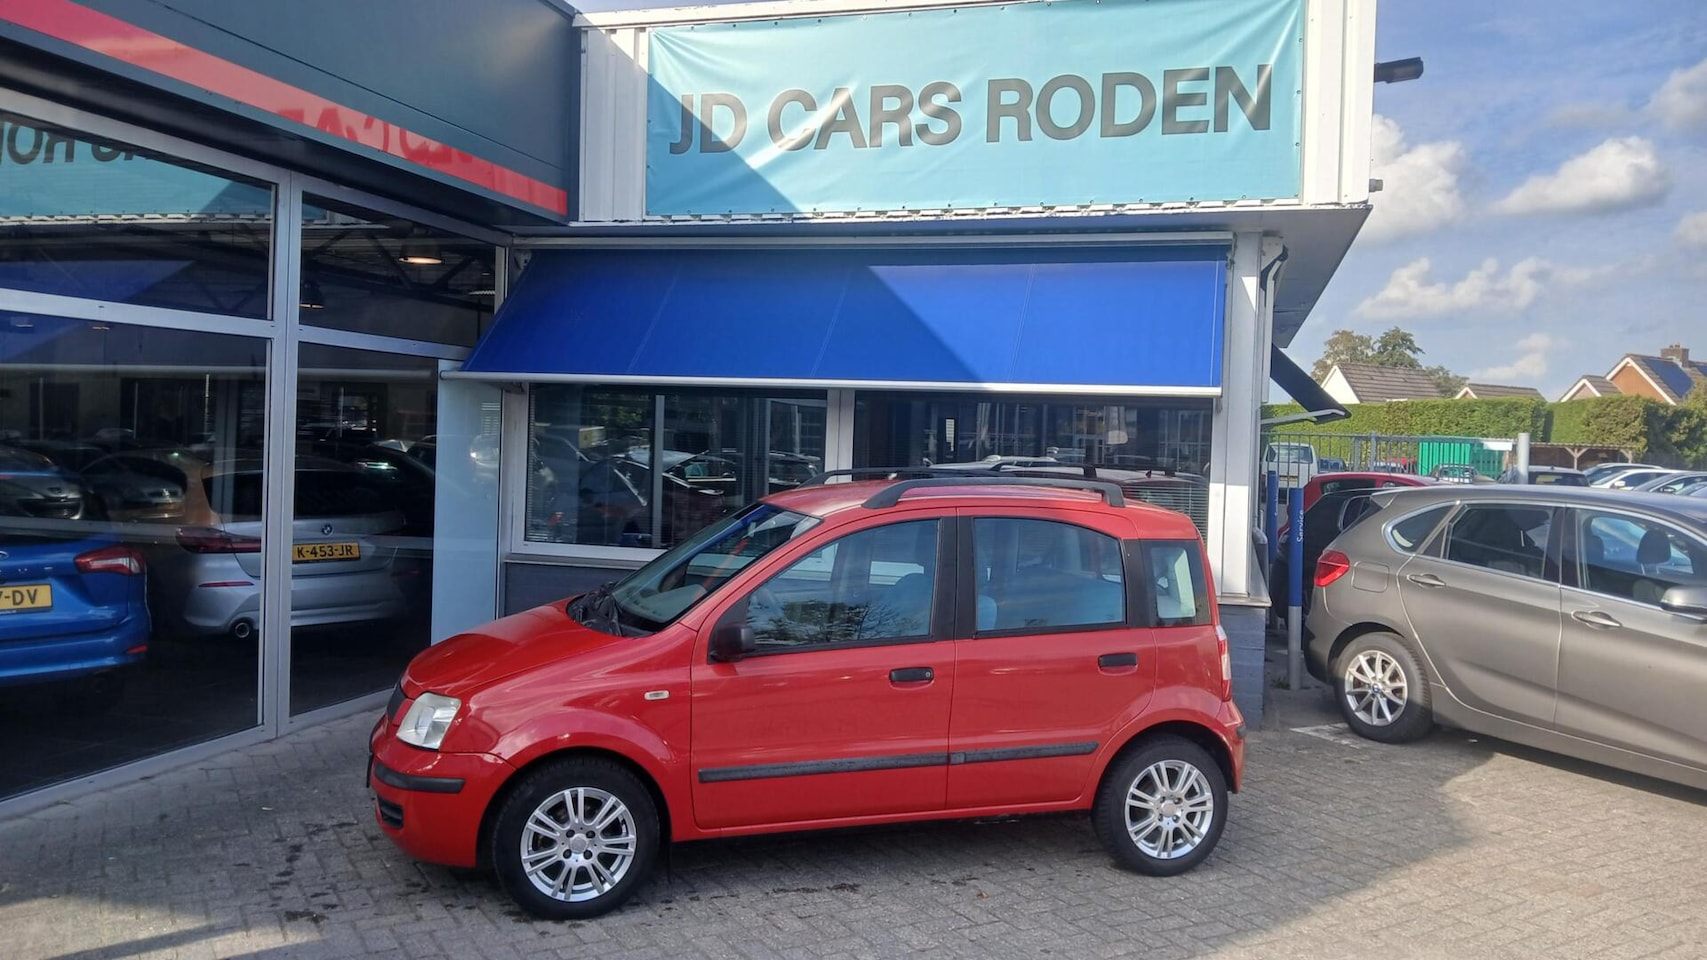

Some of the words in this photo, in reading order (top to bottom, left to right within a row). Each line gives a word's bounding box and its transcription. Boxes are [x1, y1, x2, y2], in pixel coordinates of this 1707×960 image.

[669, 93, 748, 154] JD
[767, 81, 962, 151] CARS
[986, 64, 1272, 143] RODEN
[1296, 509, 1304, 542] Service
[297, 544, 354, 558] K-453-JR
